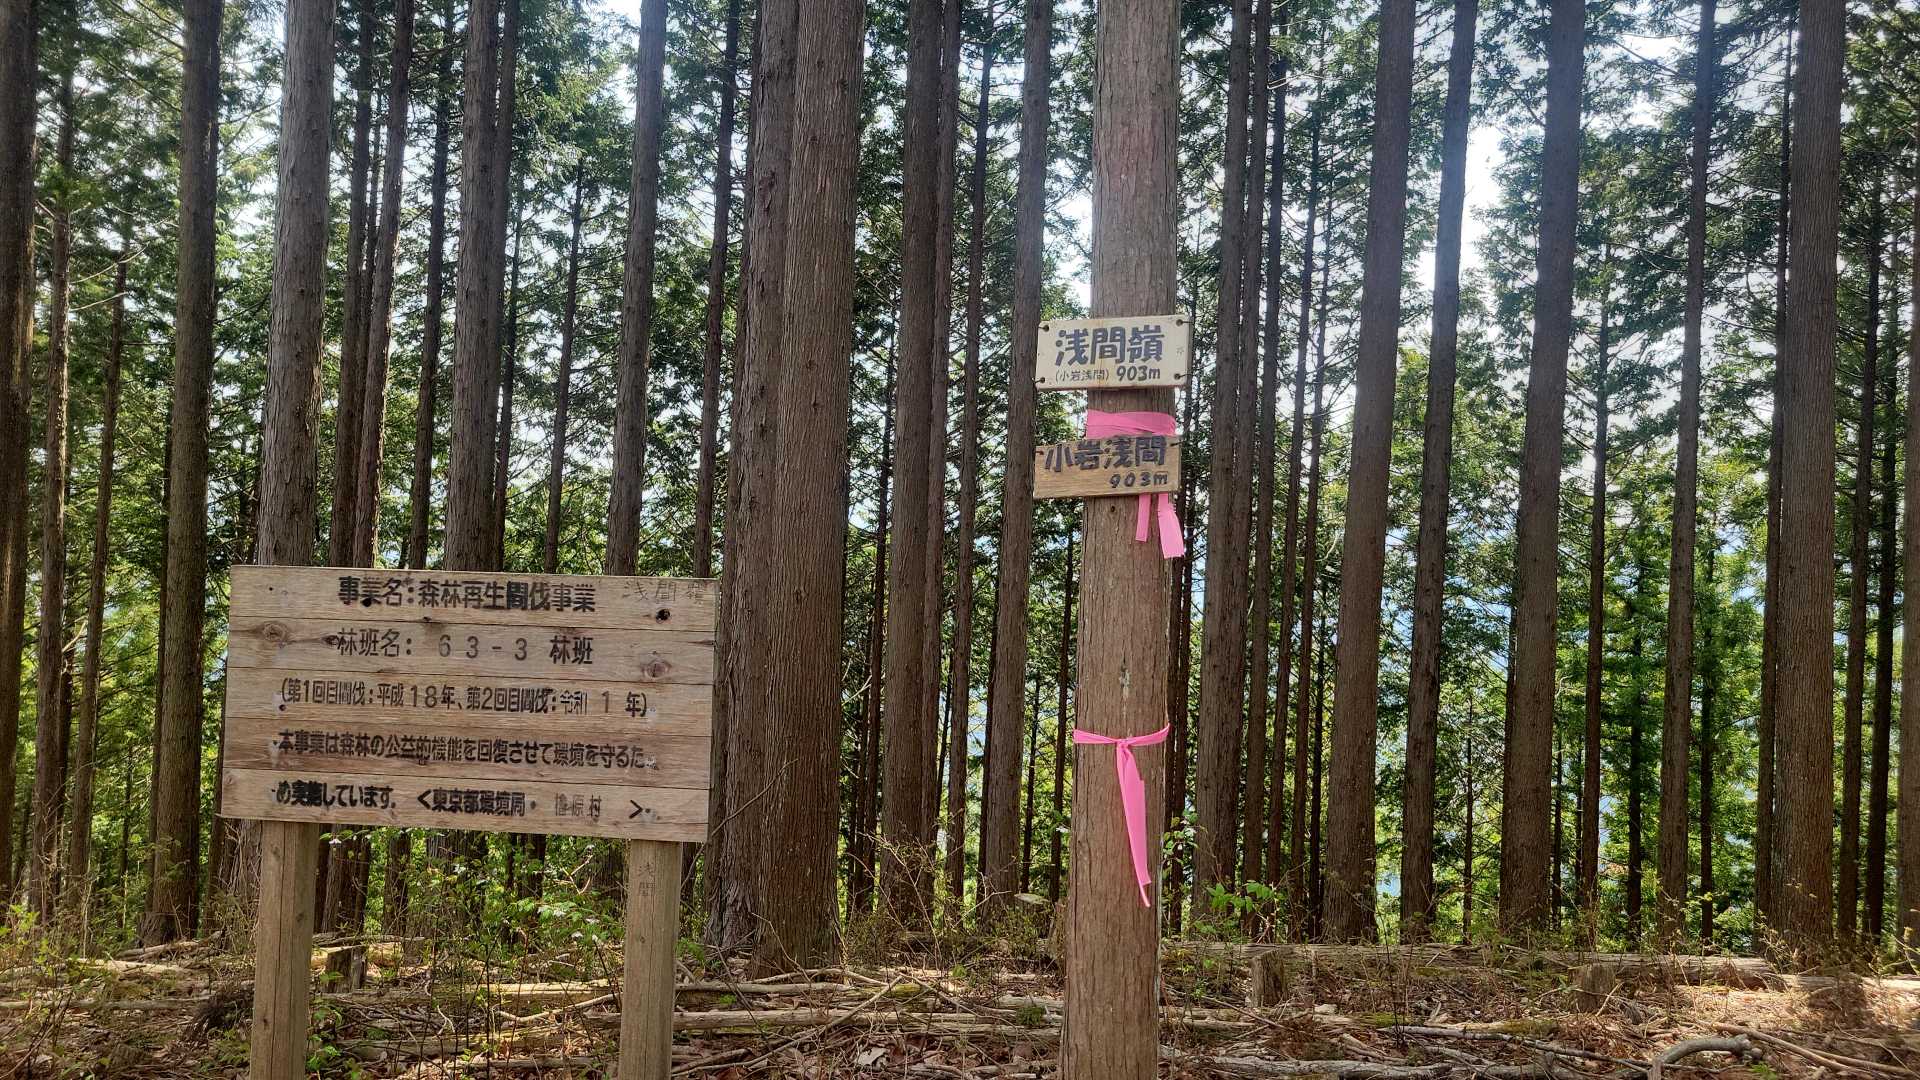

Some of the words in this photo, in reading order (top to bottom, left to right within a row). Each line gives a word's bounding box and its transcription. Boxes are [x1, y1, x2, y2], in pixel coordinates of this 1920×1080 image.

[1055, 325, 1164, 366] 浅間嶺
[1116, 365, 1160, 382] 903m
[1044, 436, 1167, 472] 小岩浅間
[1109, 471, 1168, 488] 903m
